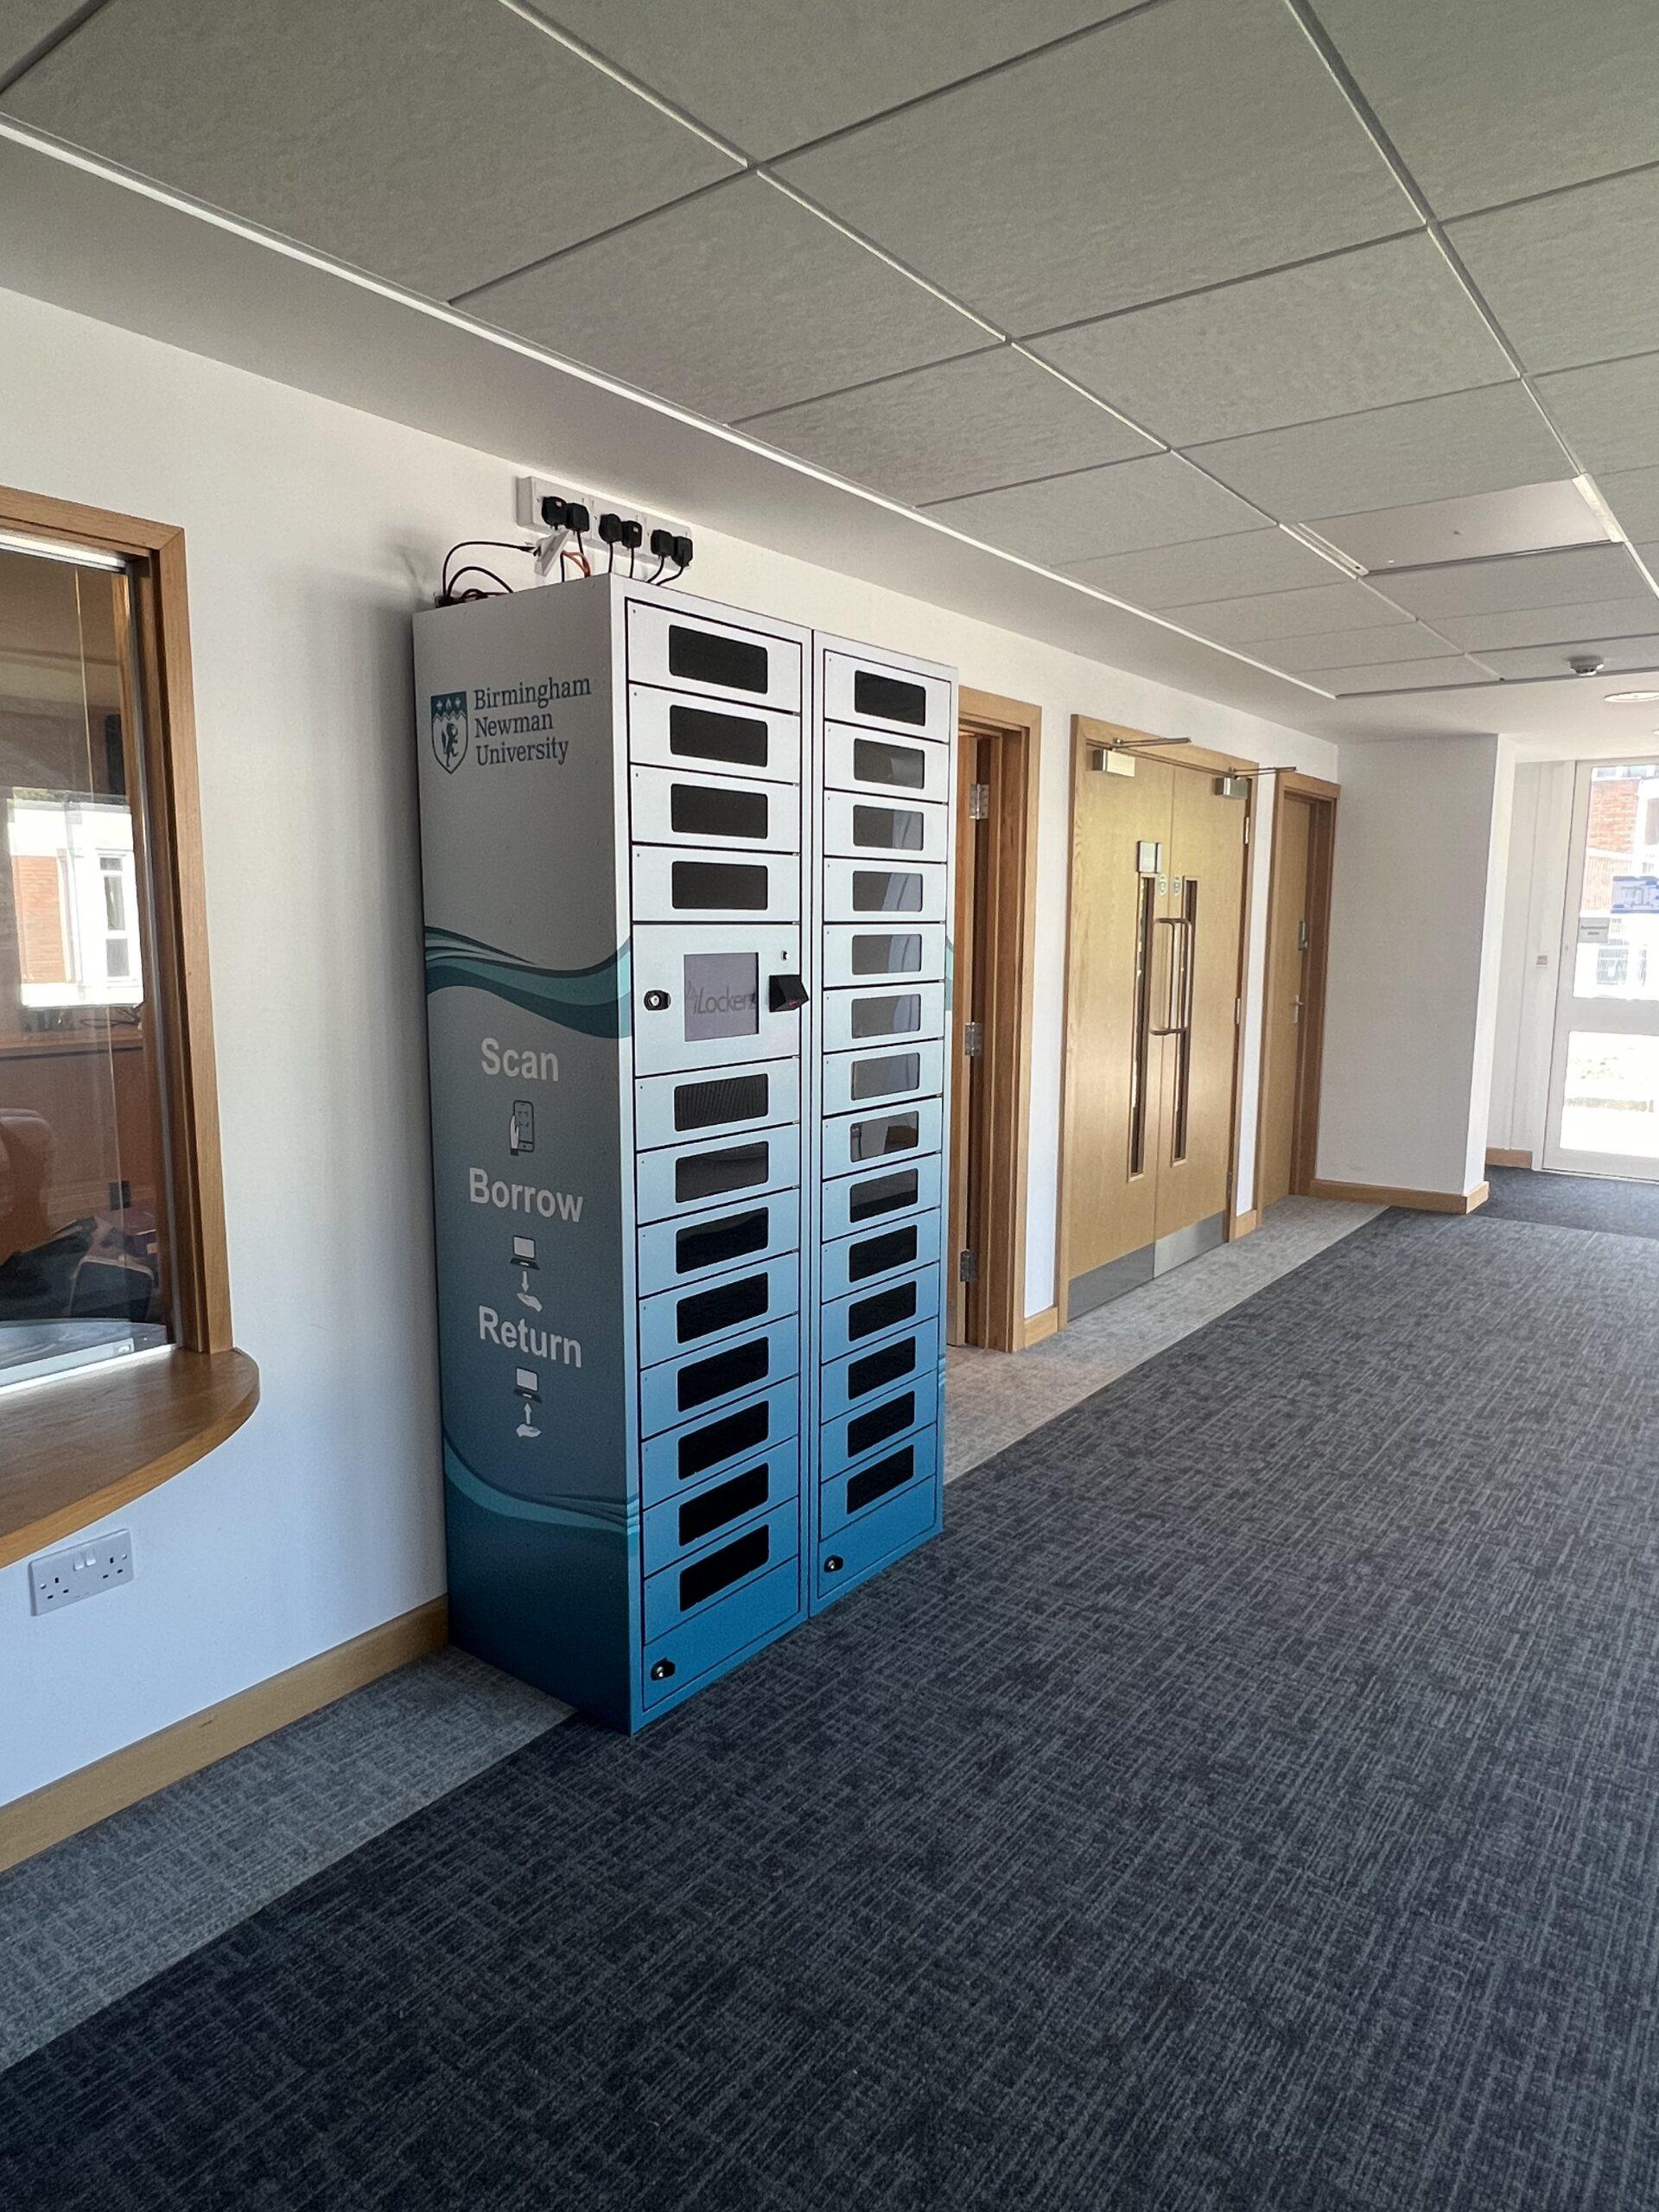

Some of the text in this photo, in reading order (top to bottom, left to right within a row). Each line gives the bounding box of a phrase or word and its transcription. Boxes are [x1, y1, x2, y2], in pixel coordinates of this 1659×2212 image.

[474, 677, 592, 709] Birmingham
[474, 712, 554, 738] Newman
[476, 737, 569, 765] University
[480, 1037, 559, 1082] Scan
[469, 1167, 584, 1223] Borrow
[478, 1306, 582, 1368] Return
